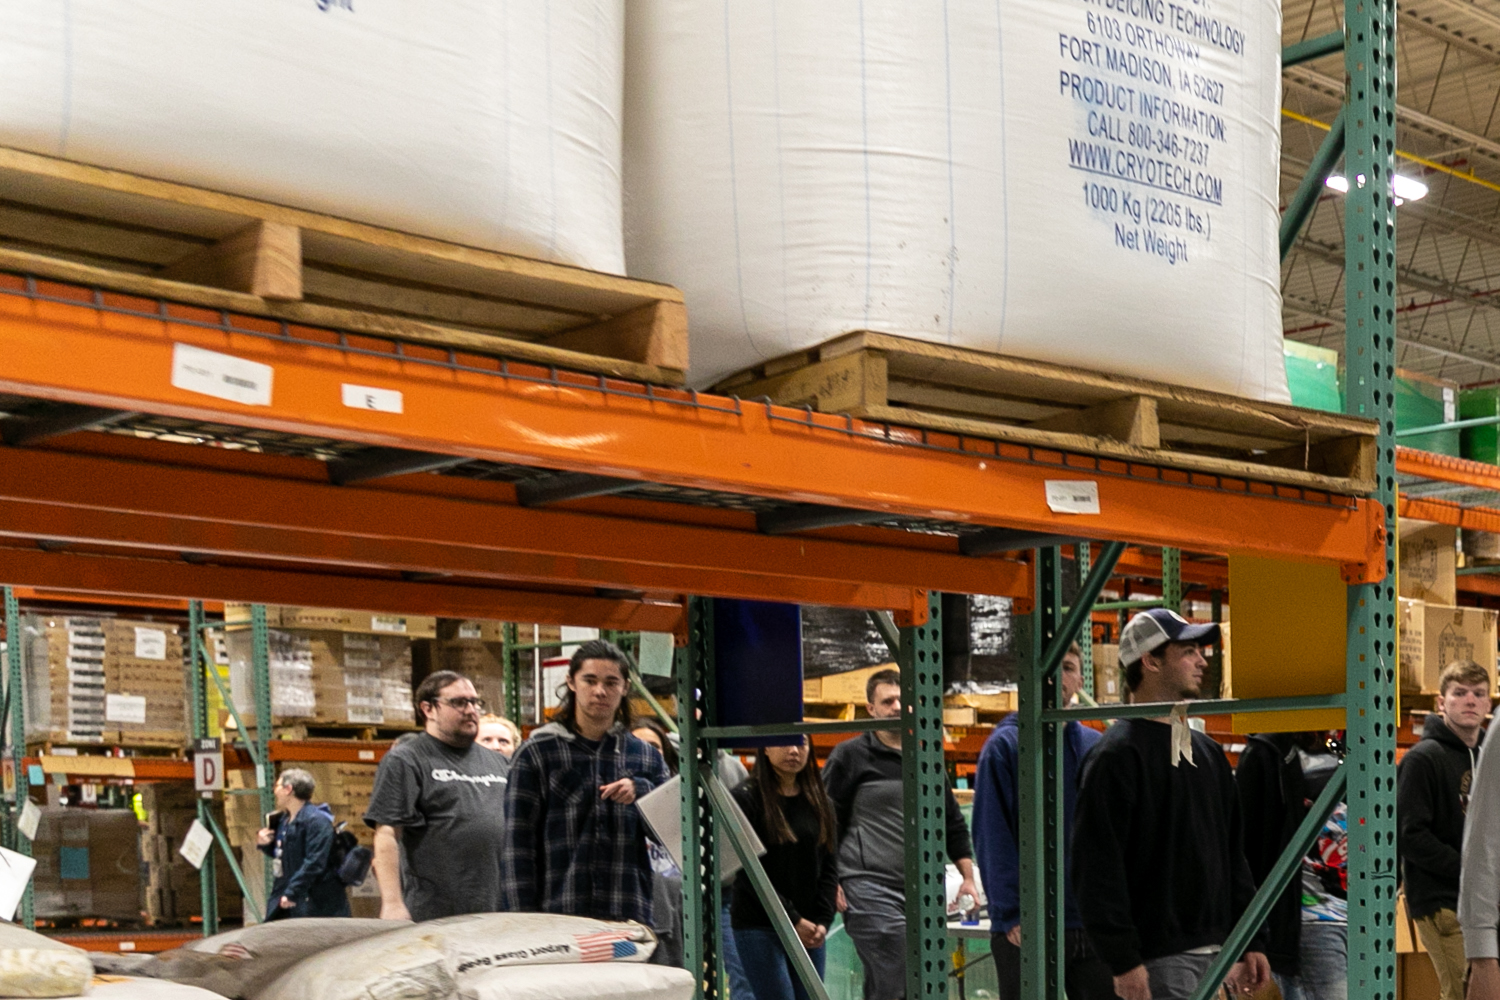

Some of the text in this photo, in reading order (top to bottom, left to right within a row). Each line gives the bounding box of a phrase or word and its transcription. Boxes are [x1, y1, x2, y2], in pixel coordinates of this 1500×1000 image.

[1087, 11, 1122, 42] 6103
[1168, 3, 1246, 58] TECHNOLOGY
[1059, 33, 1103, 67] FORT
[1178, 69, 1192, 94] IA
[1193, 73, 1224, 106] 52627
[1059, 70, 1136, 115] PRODUCT
[1088, 111, 1210, 167] CALL 800-346-7237
[1068, 139, 1223, 203] WWW.CRYOTECH.COM
[1082, 182, 1119, 214] 1000
[1122, 190, 1142, 225] Kg
[1145, 196, 1183, 231] (2205
[1114, 223, 1189, 265] Net Weight
[203, 757, 216, 786] D
